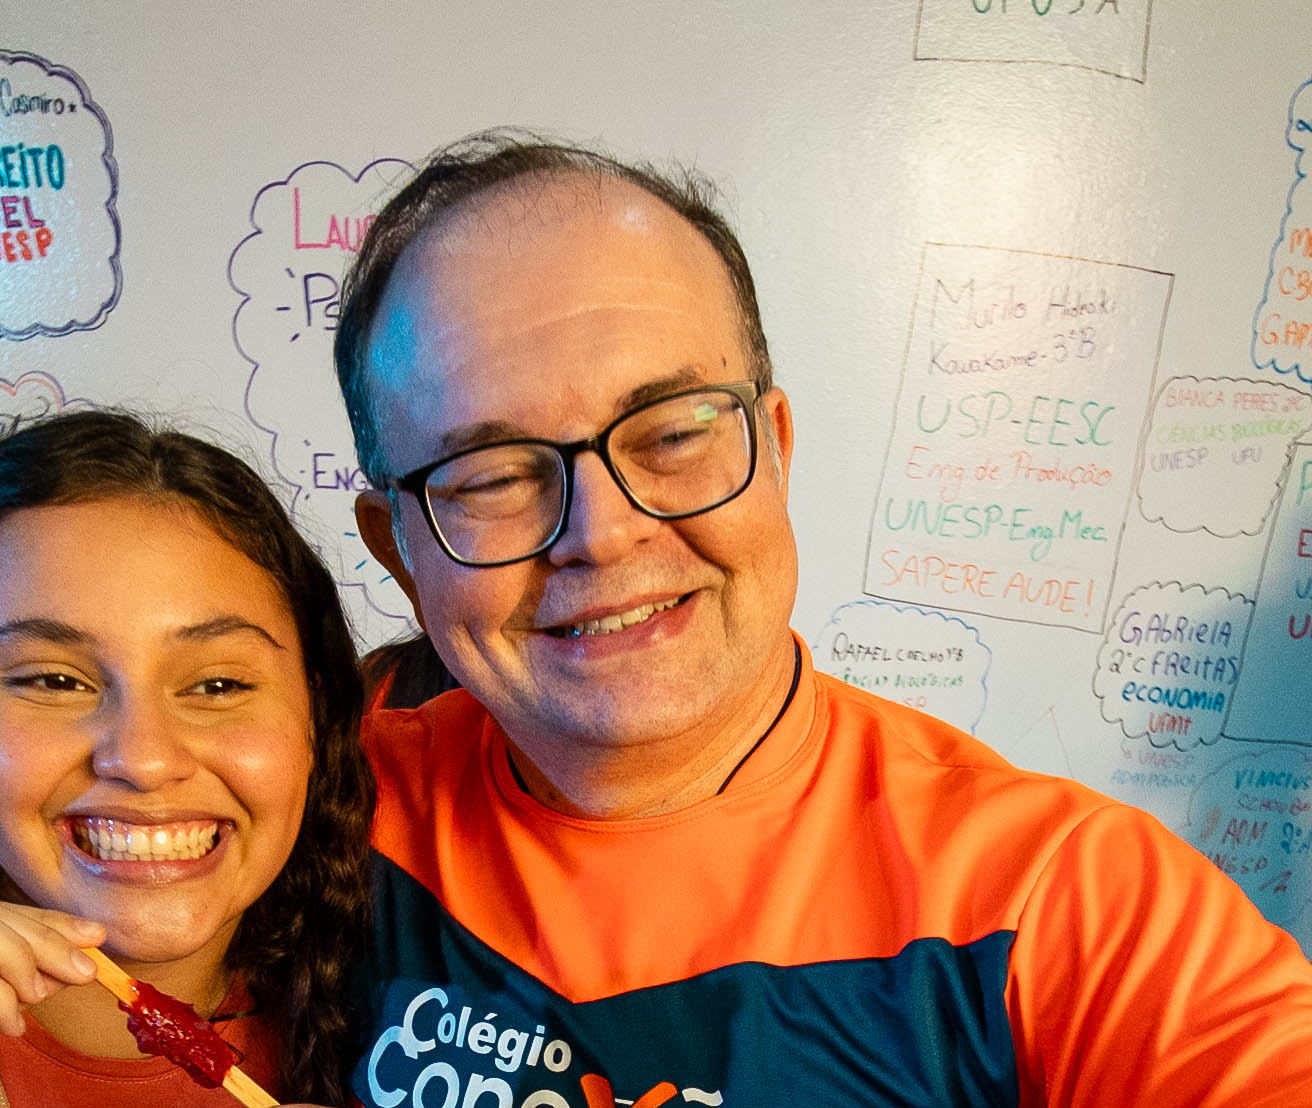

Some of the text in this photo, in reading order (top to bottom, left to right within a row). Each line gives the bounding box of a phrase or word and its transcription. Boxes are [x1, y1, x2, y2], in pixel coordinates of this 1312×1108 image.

[916, 390, 1116, 448] USP-EESC
[975, 460, 1001, 482] de
[880, 549, 999, 599] SAPERE
[402, 986, 573, 1074] Colégio
